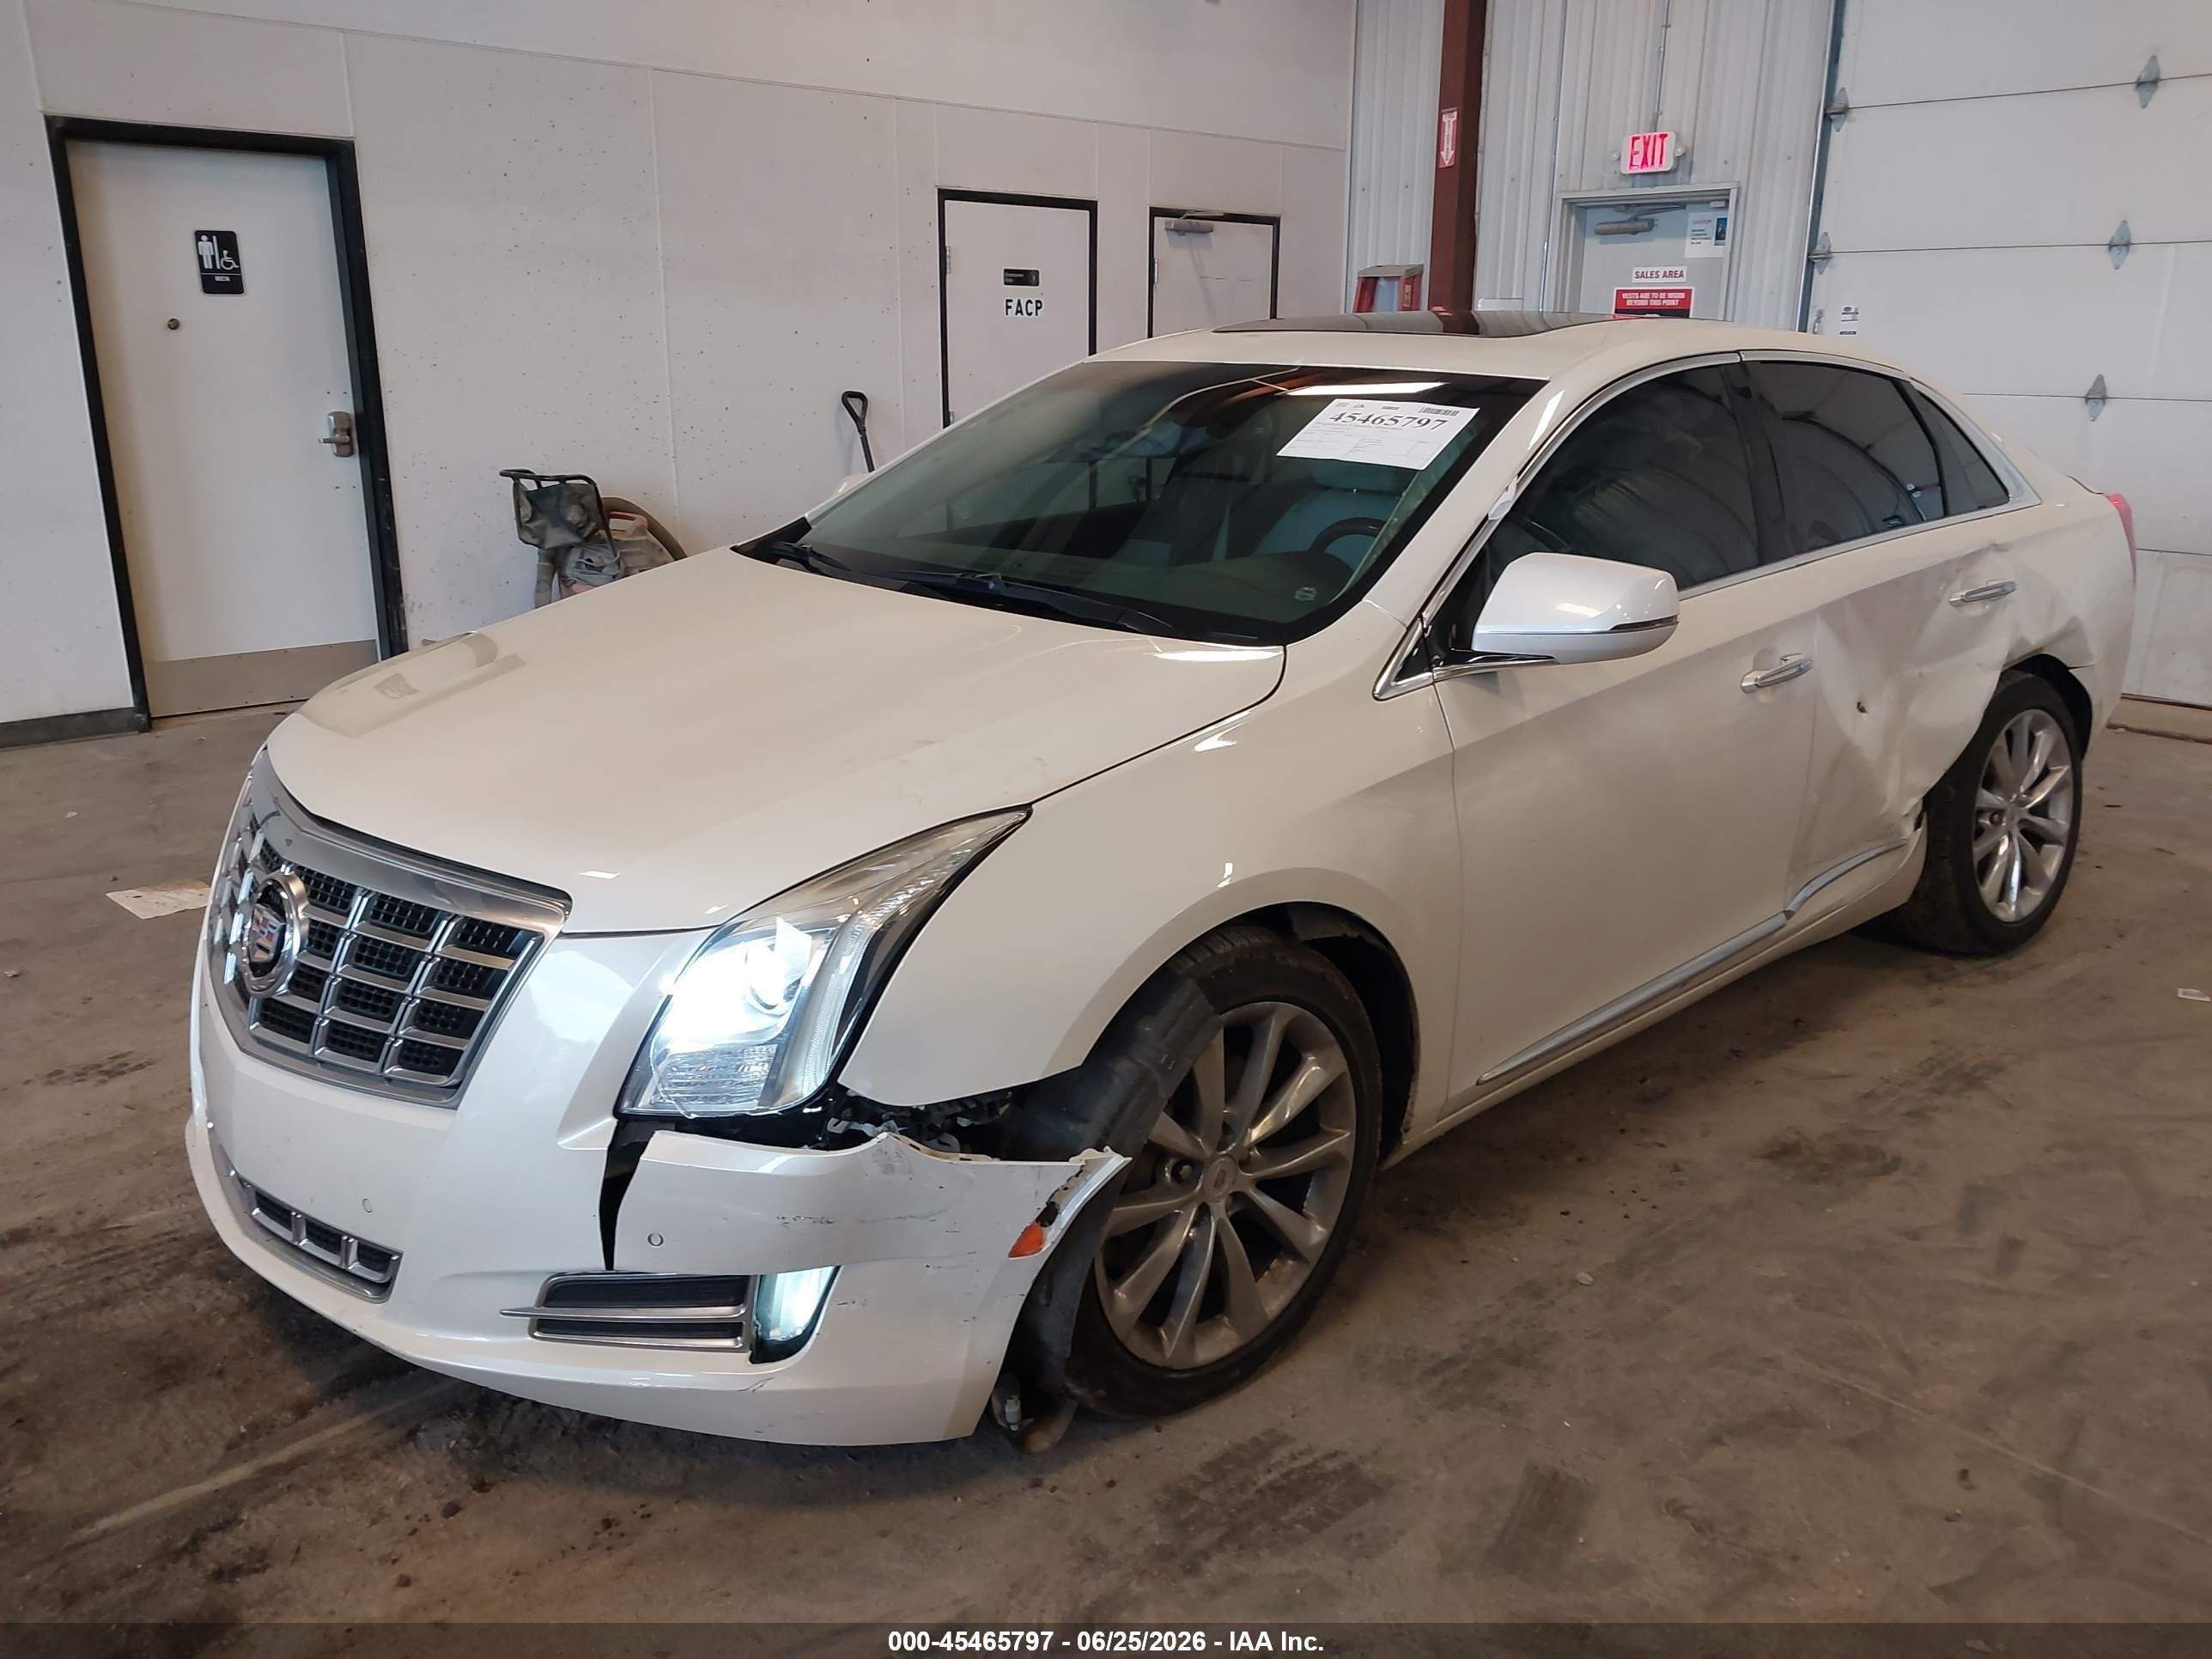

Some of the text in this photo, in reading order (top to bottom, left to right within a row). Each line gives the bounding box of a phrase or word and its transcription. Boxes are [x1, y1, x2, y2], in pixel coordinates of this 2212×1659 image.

[1629, 133, 1668, 170] EXIT
[1634, 270, 1684, 279] SALES AREA
[1005, 298, 1043, 317] FACP
[1329, 411, 1449, 431] 45465797
